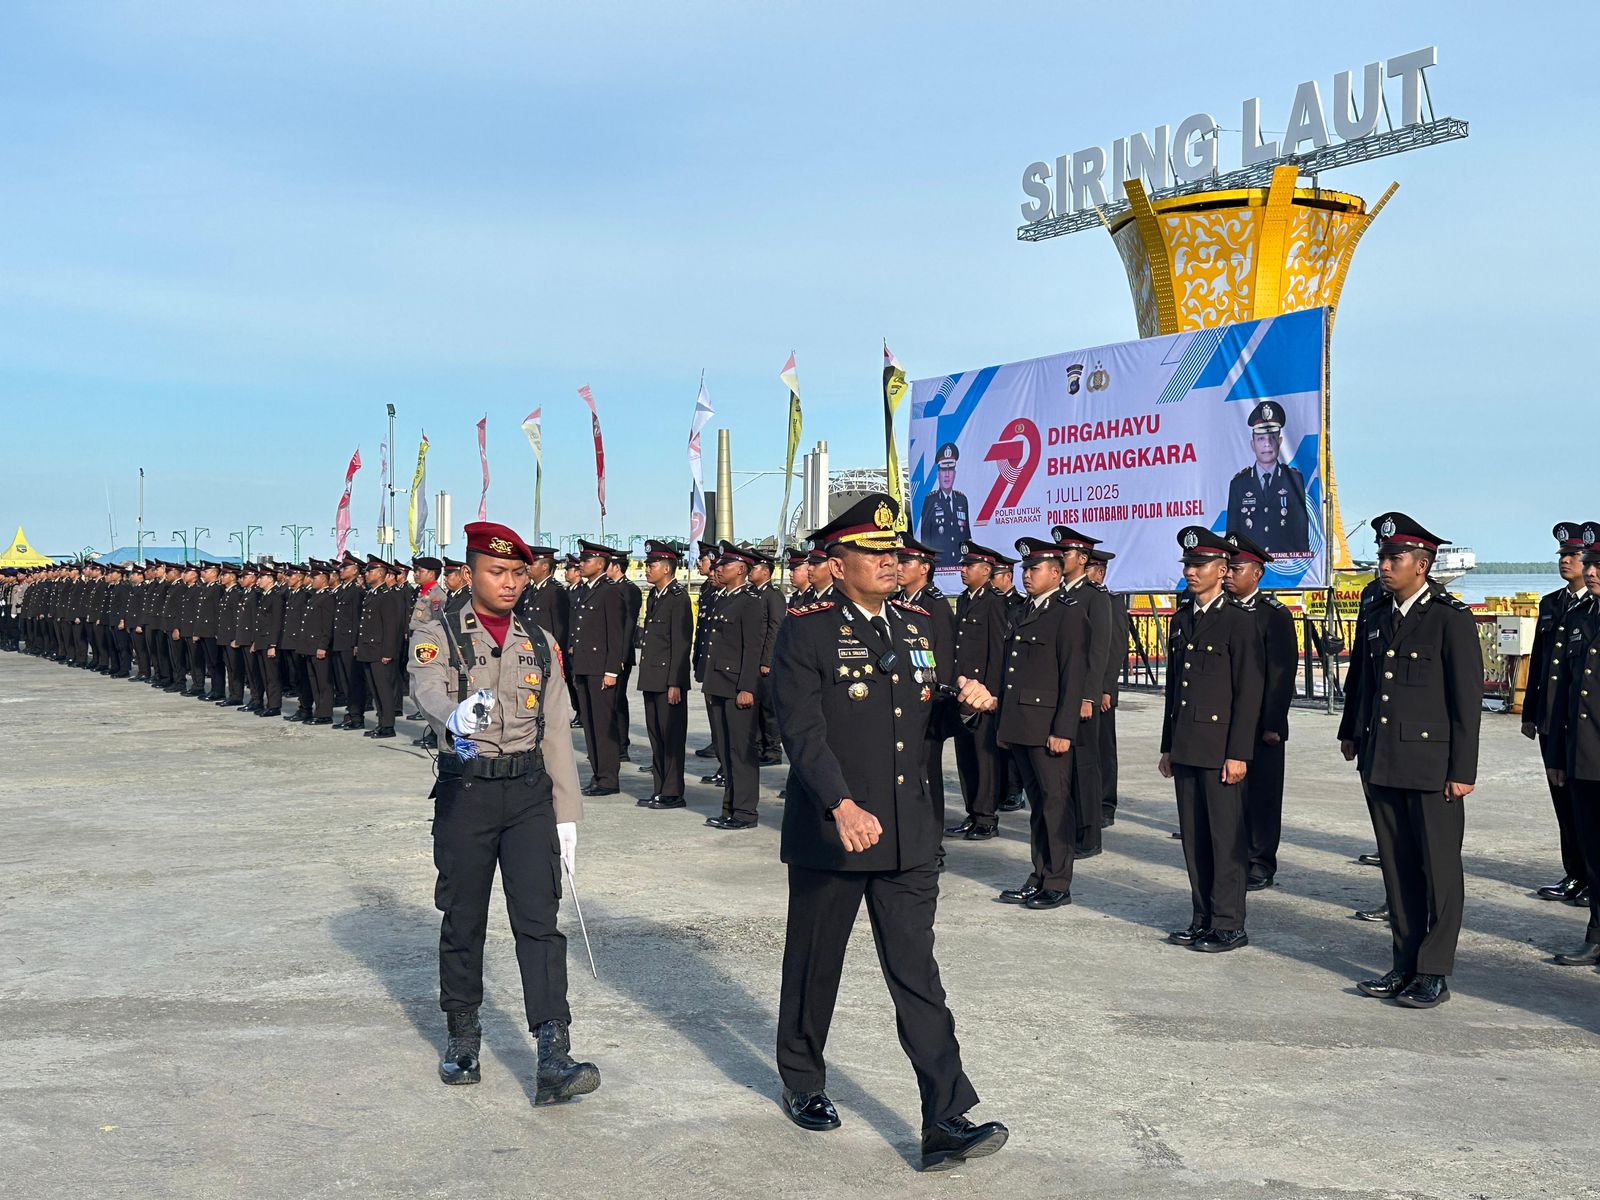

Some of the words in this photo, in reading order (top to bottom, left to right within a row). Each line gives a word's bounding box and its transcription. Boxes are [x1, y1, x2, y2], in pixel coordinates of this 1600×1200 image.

[1020, 113, 1218, 223] SIRING
[1242, 46, 1437, 167] LAUT
[1048, 414, 1160, 446] DIRGAHAYU
[1047, 443, 1197, 476] BHAYANGKARA
[1046, 490, 1051, 504] 1
[1055, 486, 1083, 504] JULI
[1087, 484, 1120, 501] 2025
[995, 509, 1016, 517] POLRI
[1016, 507, 1041, 516] UNTUK
[995, 515, 1042, 524] MASYARAKAT
[1047, 509, 1079, 525] POLRES
[1082, 505, 1128, 523] KOTABARU
[1132, 503, 1163, 519] POLDA
[1166, 499, 1204, 517] KALSEL
